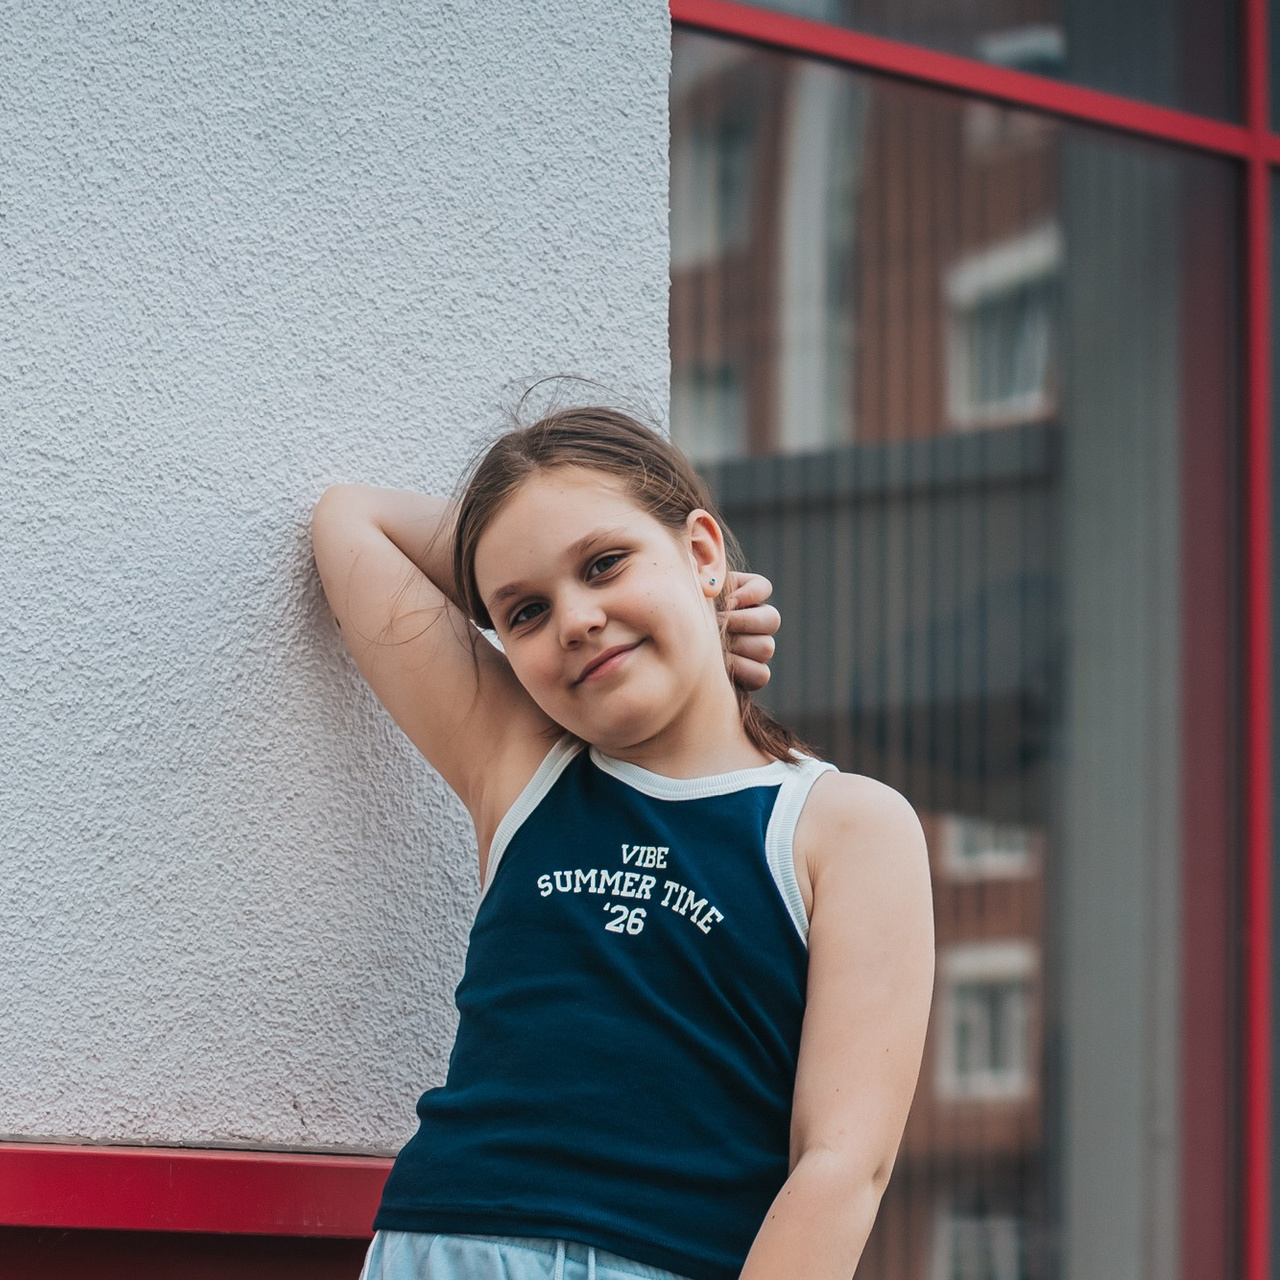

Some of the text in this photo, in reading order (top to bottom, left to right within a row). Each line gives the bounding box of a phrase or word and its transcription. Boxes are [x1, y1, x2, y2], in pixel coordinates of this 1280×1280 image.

[621, 844, 669, 869] VIBE
[537, 868, 724, 935] SUMMER TIME
[603, 902, 647, 935] '26
